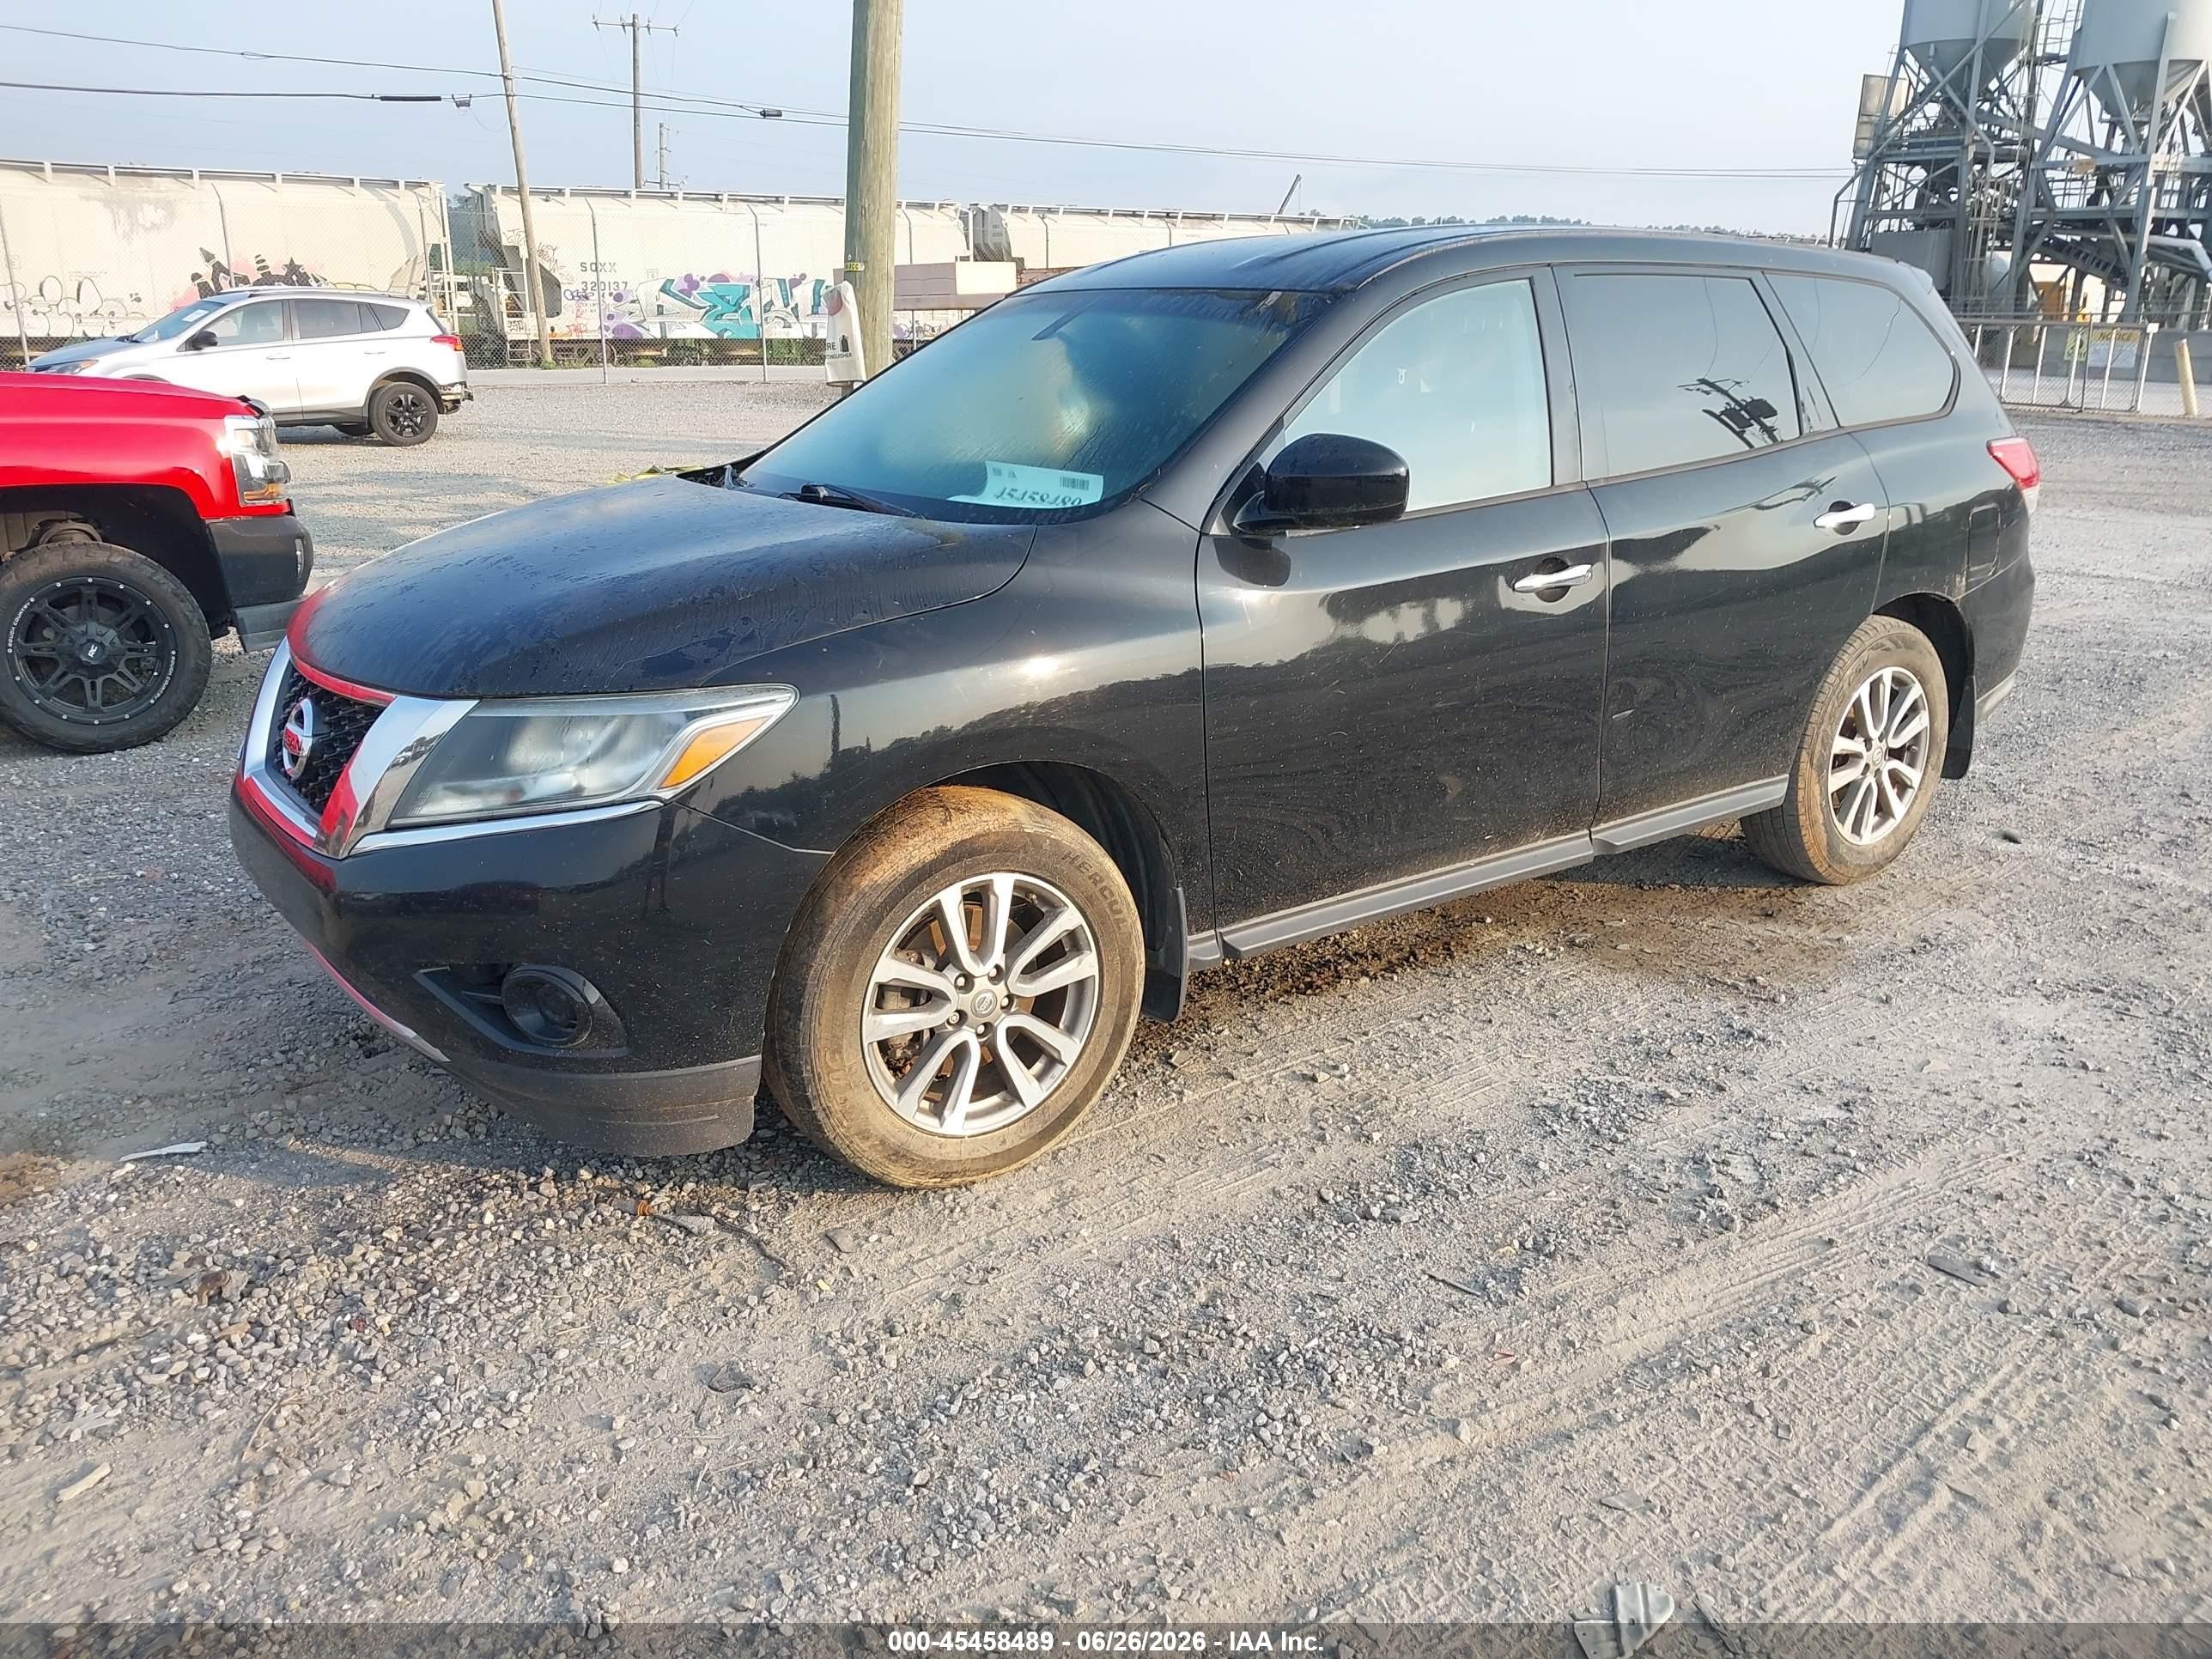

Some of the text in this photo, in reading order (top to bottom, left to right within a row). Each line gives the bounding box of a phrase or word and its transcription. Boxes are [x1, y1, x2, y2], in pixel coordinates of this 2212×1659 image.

[580, 282, 629, 292] 320137
[2098, 331, 2132, 341] NOICE
[826, 342, 836, 351] RE
[8, 602, 31, 647] ROUGH COUNTRY
[1061, 850, 1129, 942] HERCUL
